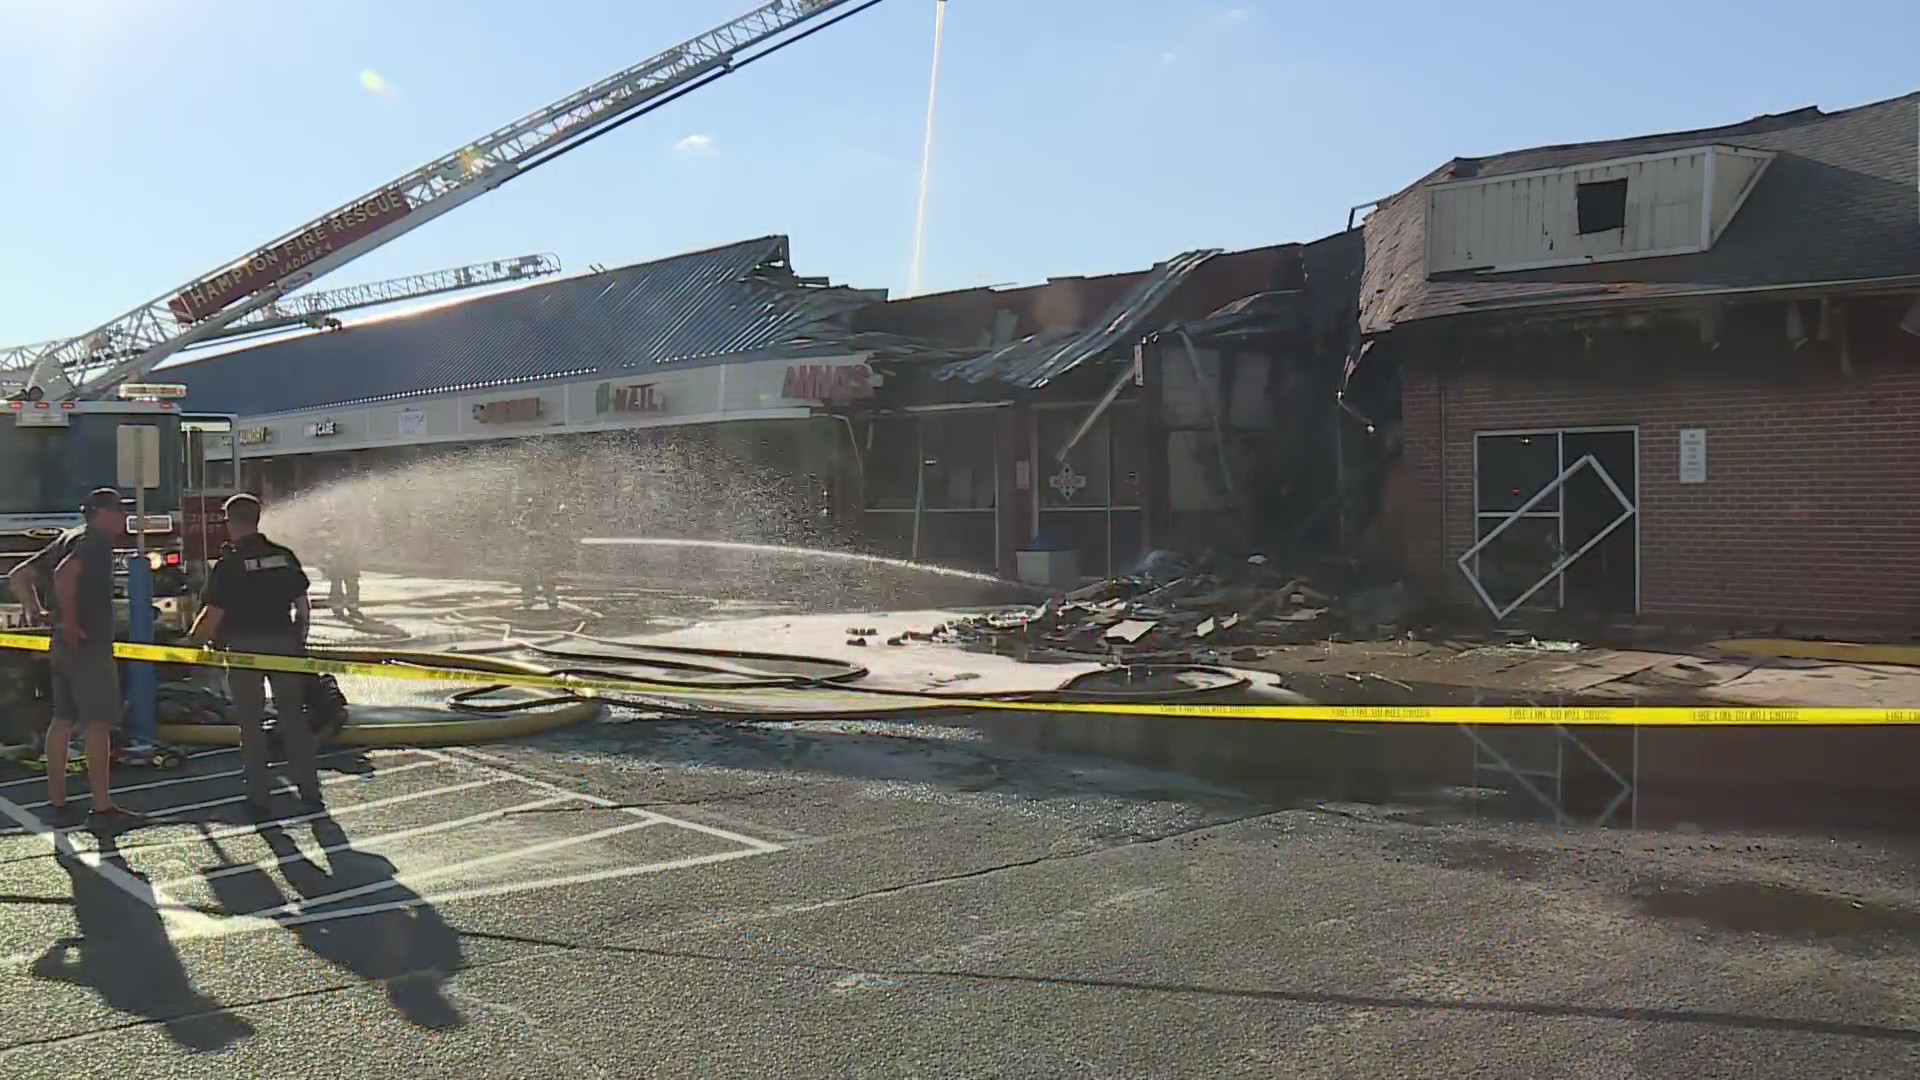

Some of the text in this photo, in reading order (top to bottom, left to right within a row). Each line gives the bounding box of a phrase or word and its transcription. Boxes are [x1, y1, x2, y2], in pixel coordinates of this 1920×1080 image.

[190, 248, 279, 308] HAMPTON
[283, 226, 329, 258] FIRE
[331, 189, 402, 233] RESCUE
[279, 247, 322, 275] LADDER
